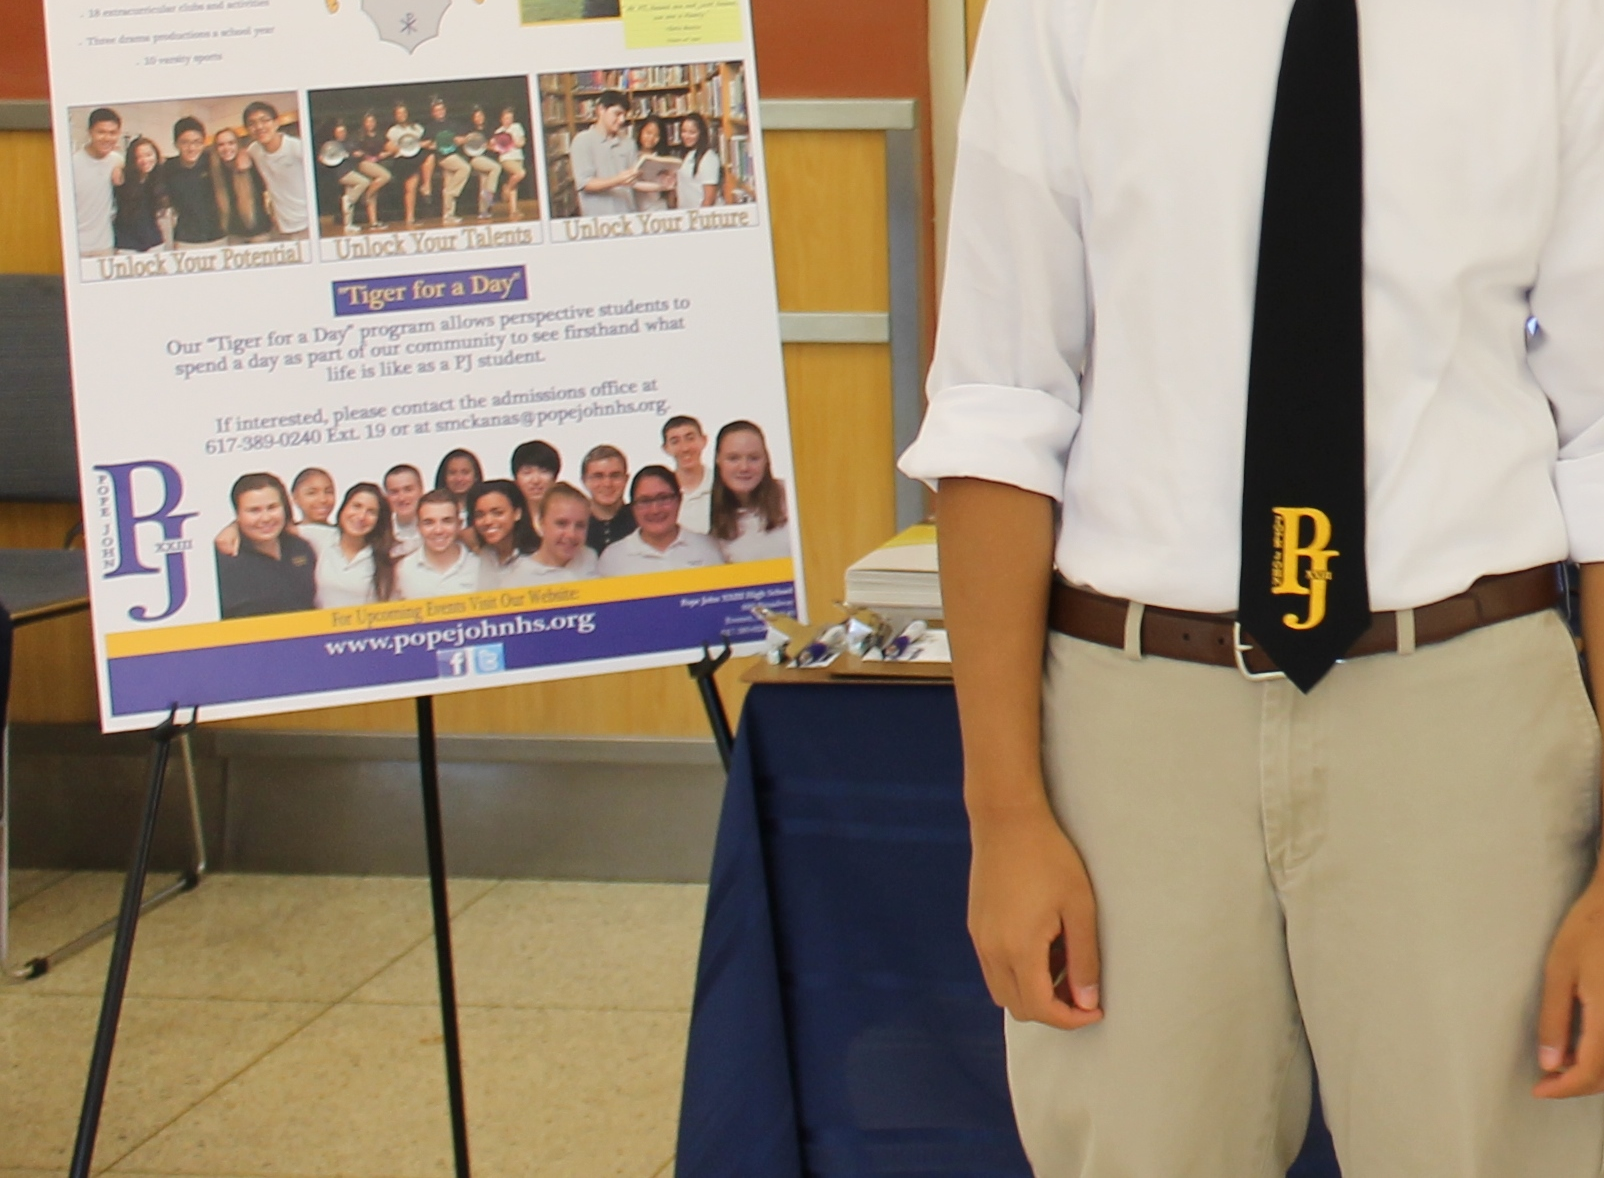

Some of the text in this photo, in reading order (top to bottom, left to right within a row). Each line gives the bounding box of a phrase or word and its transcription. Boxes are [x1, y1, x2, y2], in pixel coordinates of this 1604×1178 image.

[102, 4, 177, 18] extracurricular
[178, 2, 204, 13] clubs
[206, 0, 224, 11] and
[86, 36, 117, 47] Three
[118, 33, 150, 44] drama
[152, 30, 211, 45] productions
[220, 26, 251, 37] school
[253, 25, 275, 39] year
[159, 53, 191, 67] varsity
[192, 51, 222, 66] sports
[333, 224, 533, 260] Unlock Your Talents
[564, 208, 749, 241] Unlock Your Future
[98, 240, 303, 280] Unlock Your Potential
[412, 280, 446, 300] for
[451, 282, 465, 296] a
[166, 339, 202, 356] Our
[267, 330, 293, 347] for
[298, 333, 307, 344] a
[360, 322, 435, 347] program
[440, 314, 495, 332] allows
[499, 305, 594, 331] perspective
[598, 298, 669, 317] students
[673, 296, 691, 311] to
[175, 315, 686, 380] spend a day as part of our community to see firsthand what
[326, 348, 546, 383] life is like as a PJ student.
[215, 378, 658, 434] If interested, please contact the admissions office at
[205, 428, 323, 455] 617-389-0240
[326, 425, 360, 443] Ext.
[365, 423, 386, 440] 19
[391, 423, 410, 436] or
[415, 420, 431, 434] at
[332, 611, 353, 627] For
[356, 606, 423, 628] Upcoming
[425, 601, 467, 617] Events
[470, 597, 498, 612] Visit
[500, 593, 525, 608] Our
[324, 612, 597, 655] www.popejohnhs.org
